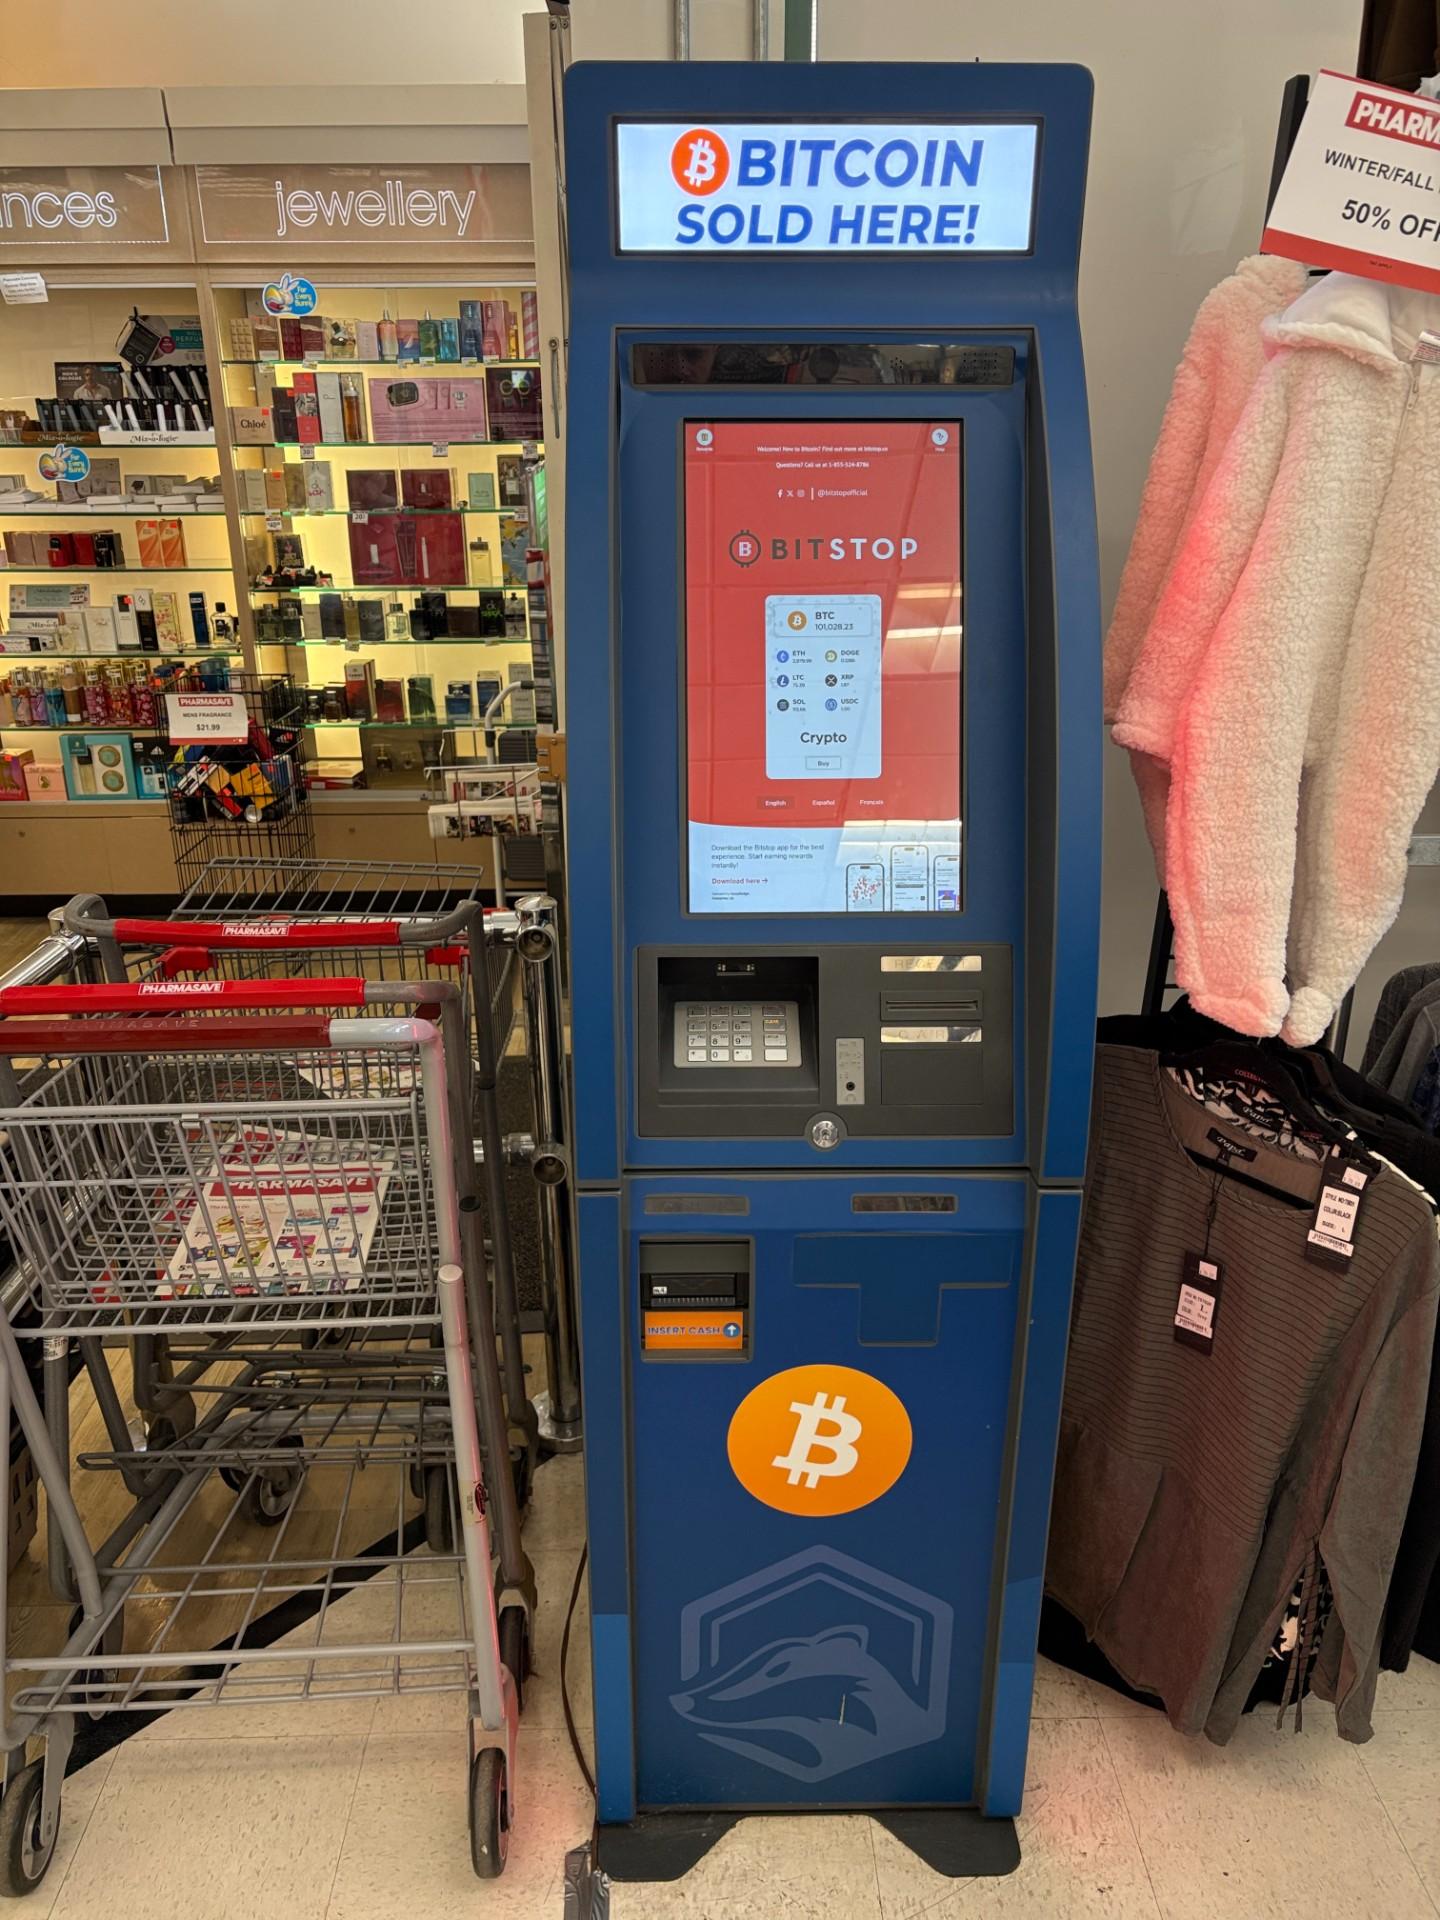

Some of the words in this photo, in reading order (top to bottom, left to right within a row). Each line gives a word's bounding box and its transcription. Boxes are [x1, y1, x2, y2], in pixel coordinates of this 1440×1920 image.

[737, 138, 985, 188] BITCOIN
[1324, 148, 1435, 192] WINTER/FALL
[276, 180, 477, 236] jewellery
[1341, 198, 1392, 231] 50%
[674, 203, 813, 245] SOLD
[828, 203, 980, 245] HERE!
[240, 418, 267, 429] Chloé
[771, 537, 918, 561] BITSTOP
[815, 611, 835, 620] BTC
[180, 697, 232, 706] PHARMASAVE
[196, 723, 221, 731] $21.99
[800, 731, 848, 745] Crypto
[711, 862, 739, 870] instantly!
[224, 926, 288, 936] PHARMASAVE
[142, 982, 222, 994] PHARMASAVE
[648, 1326, 686, 1335] INSERT
[688, 1326, 720, 1335] CASH
